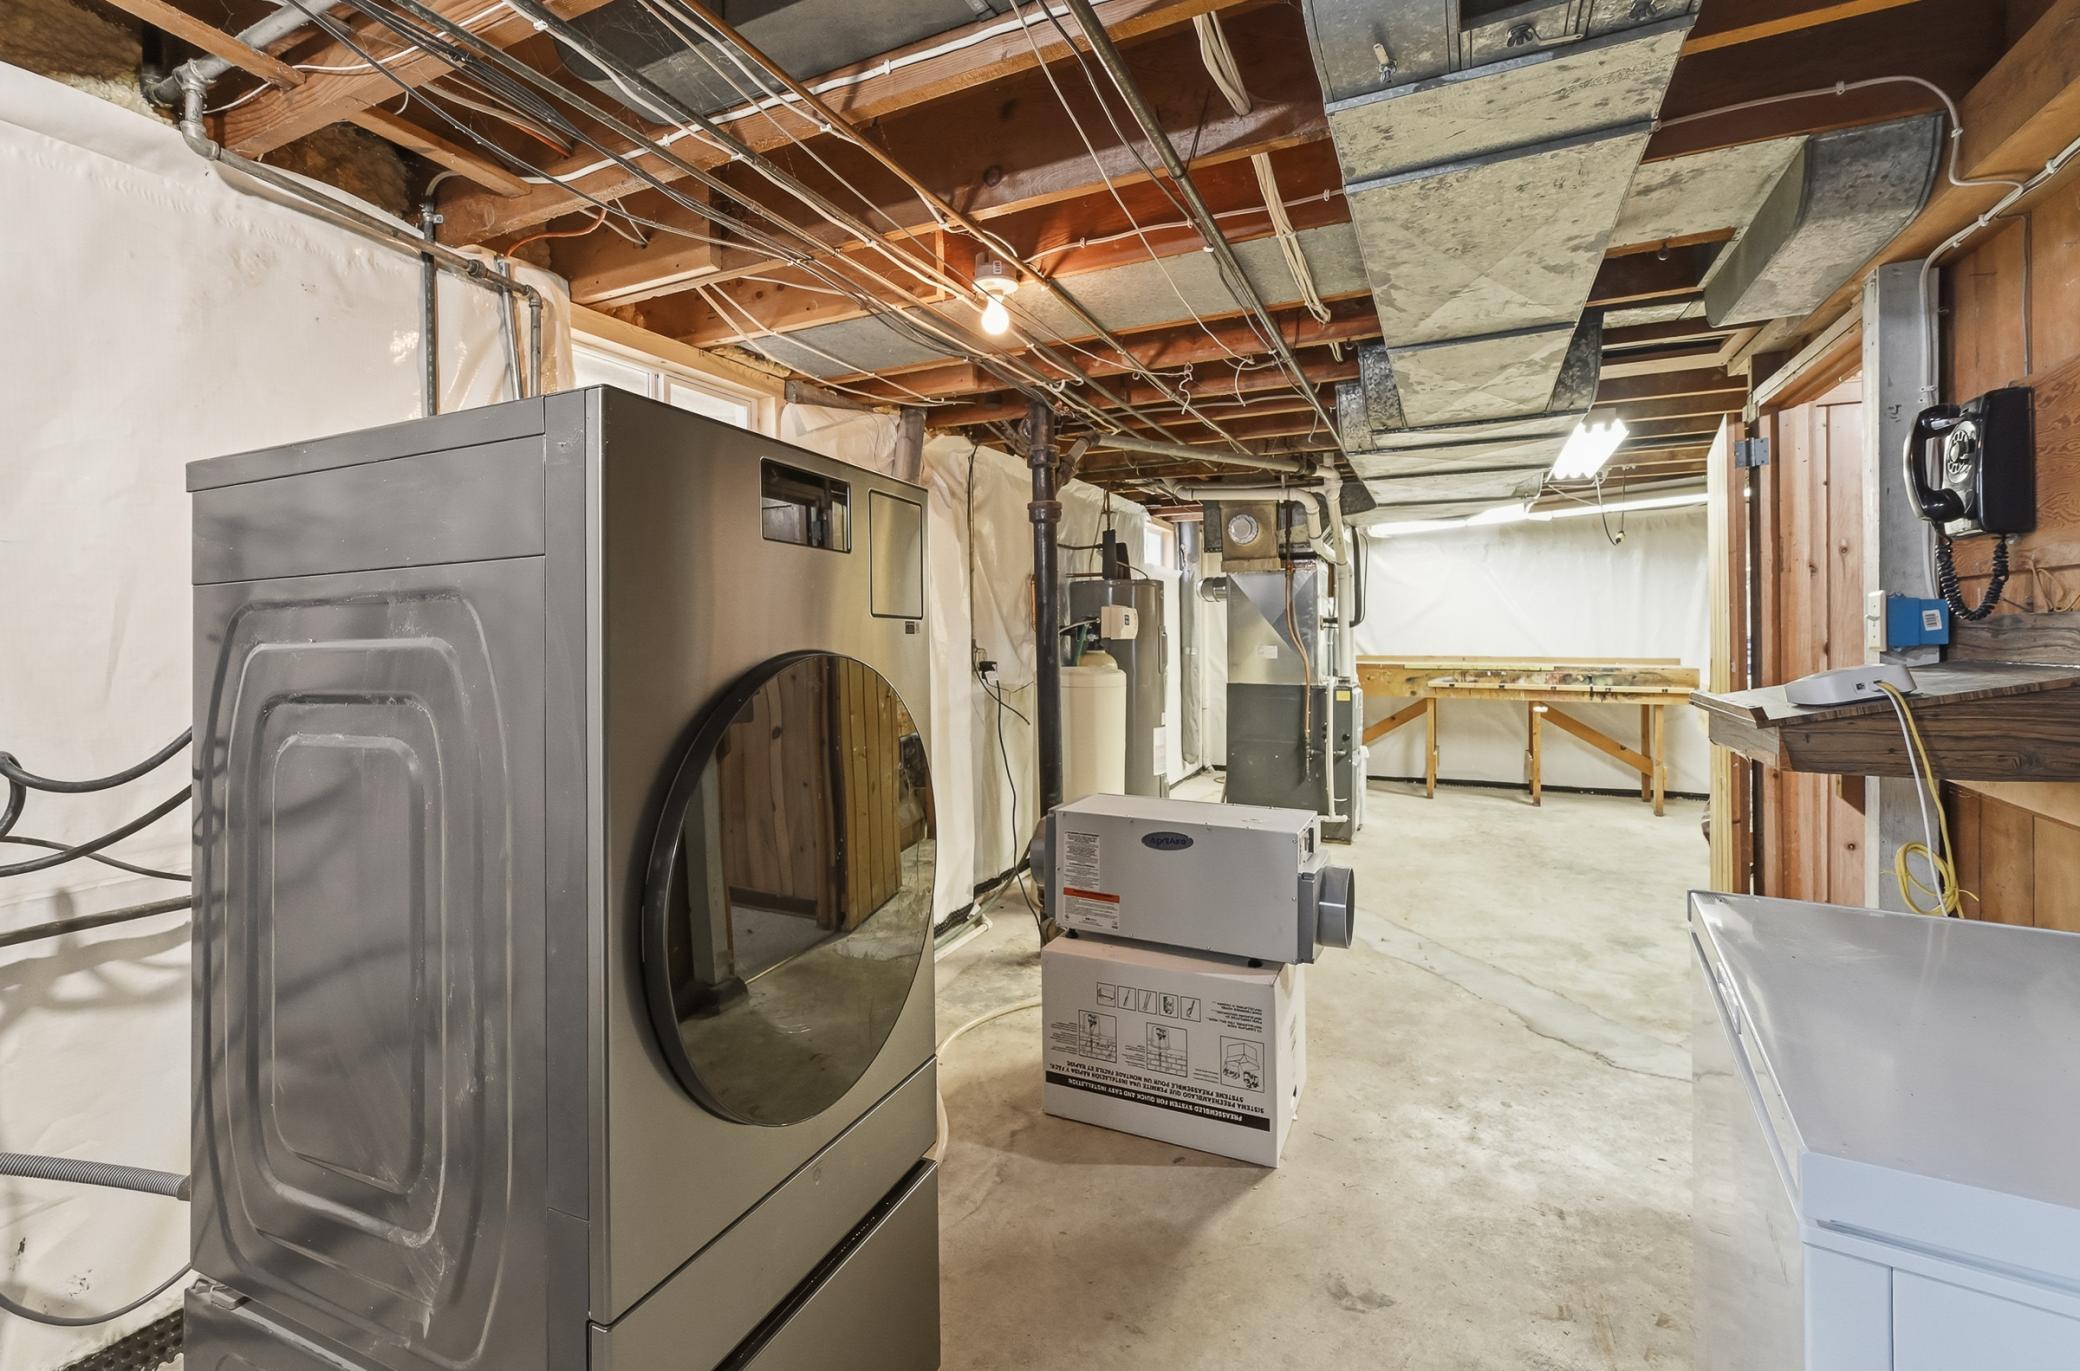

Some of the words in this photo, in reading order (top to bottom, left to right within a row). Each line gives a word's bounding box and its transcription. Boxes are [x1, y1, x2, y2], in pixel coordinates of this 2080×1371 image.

[1143, 1076, 1153, 1084] UN
[1153, 1079, 1170, 1088] POUR
[1107, 1087, 1123, 1096] EASY
[1123, 1090, 1136, 1098] AND
[1169, 1088, 1182, 1097] QUE
[1136, 1094, 1156, 1103] QUICK
[1156, 1097, 1169, 1106] FOR
[1169, 1100, 1193, 1111] SYSTEM
[1193, 1105, 1243, 1122] PREASSEMBLED
